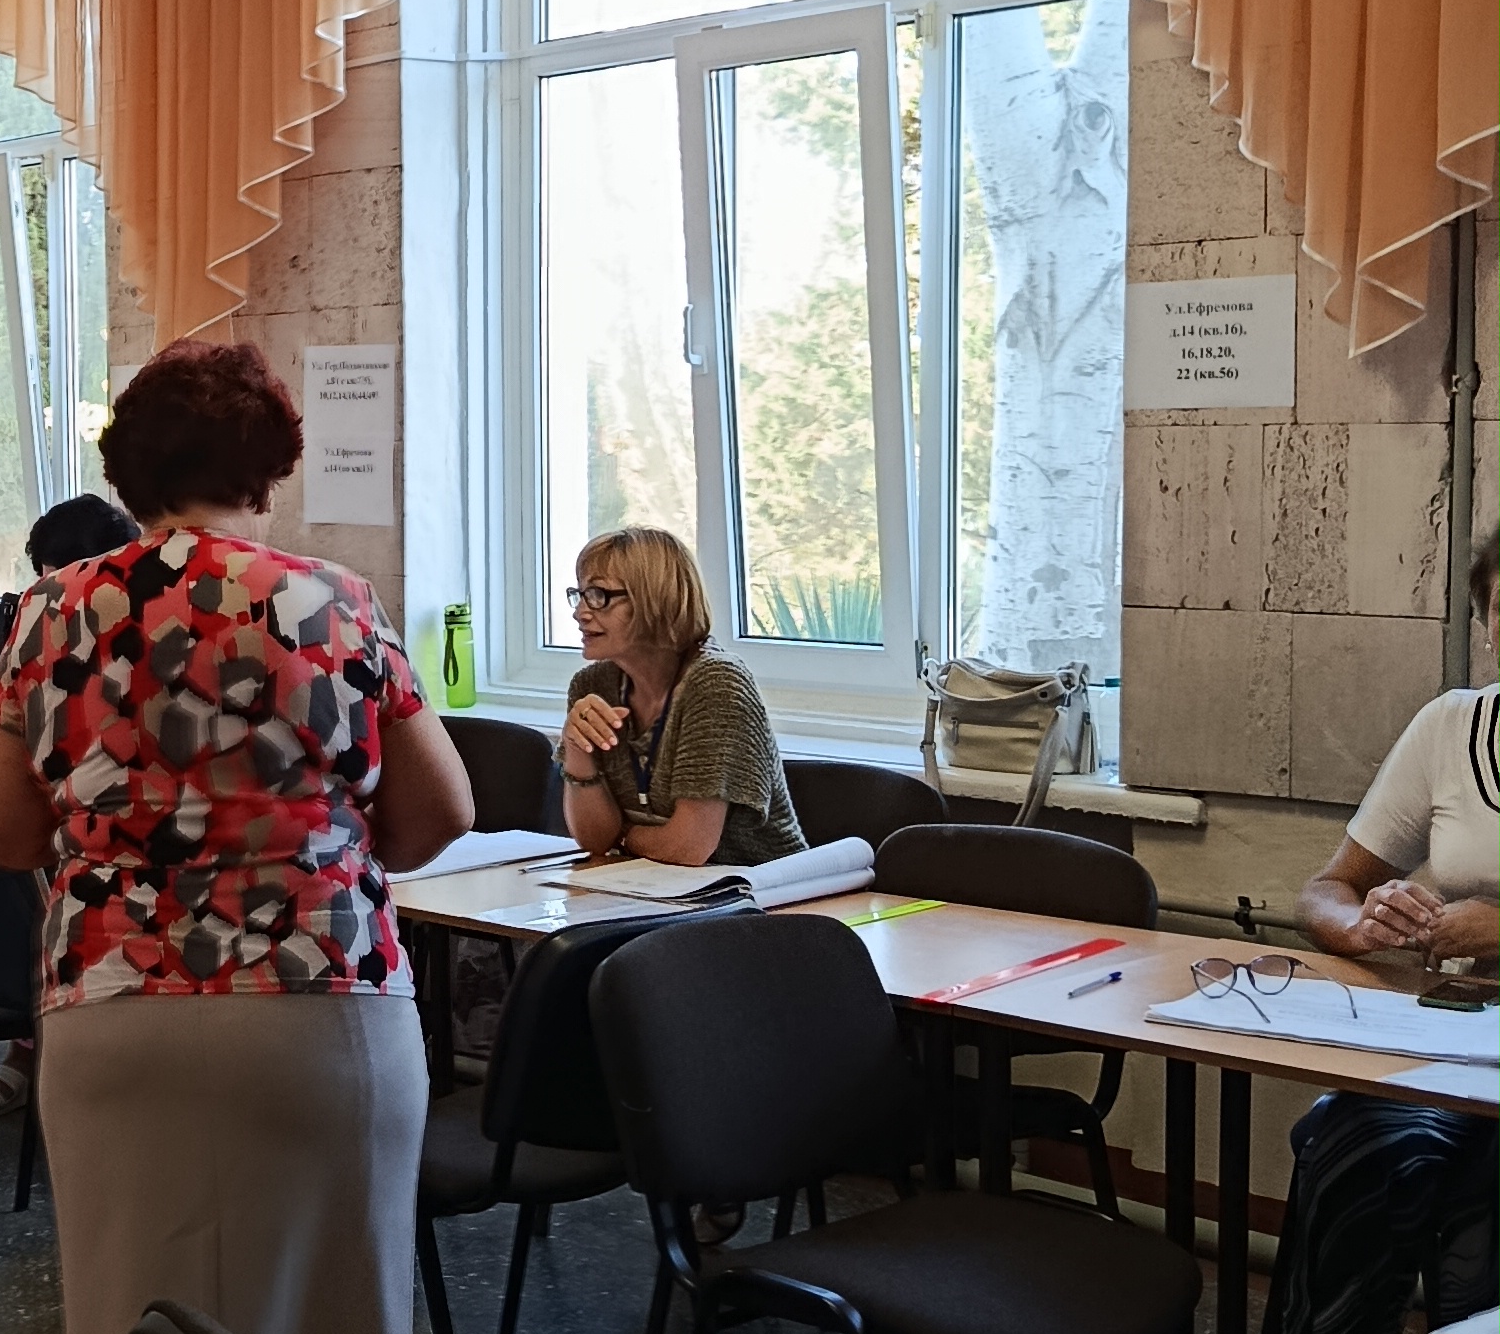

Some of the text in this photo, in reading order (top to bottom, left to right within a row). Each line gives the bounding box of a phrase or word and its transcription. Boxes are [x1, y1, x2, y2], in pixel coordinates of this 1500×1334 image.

[1164, 302, 1254, 317] Ул.Ефремова
[1169, 324, 1195, 338] д.14
[1176, 366, 1239, 382] 22 (кв.56)
